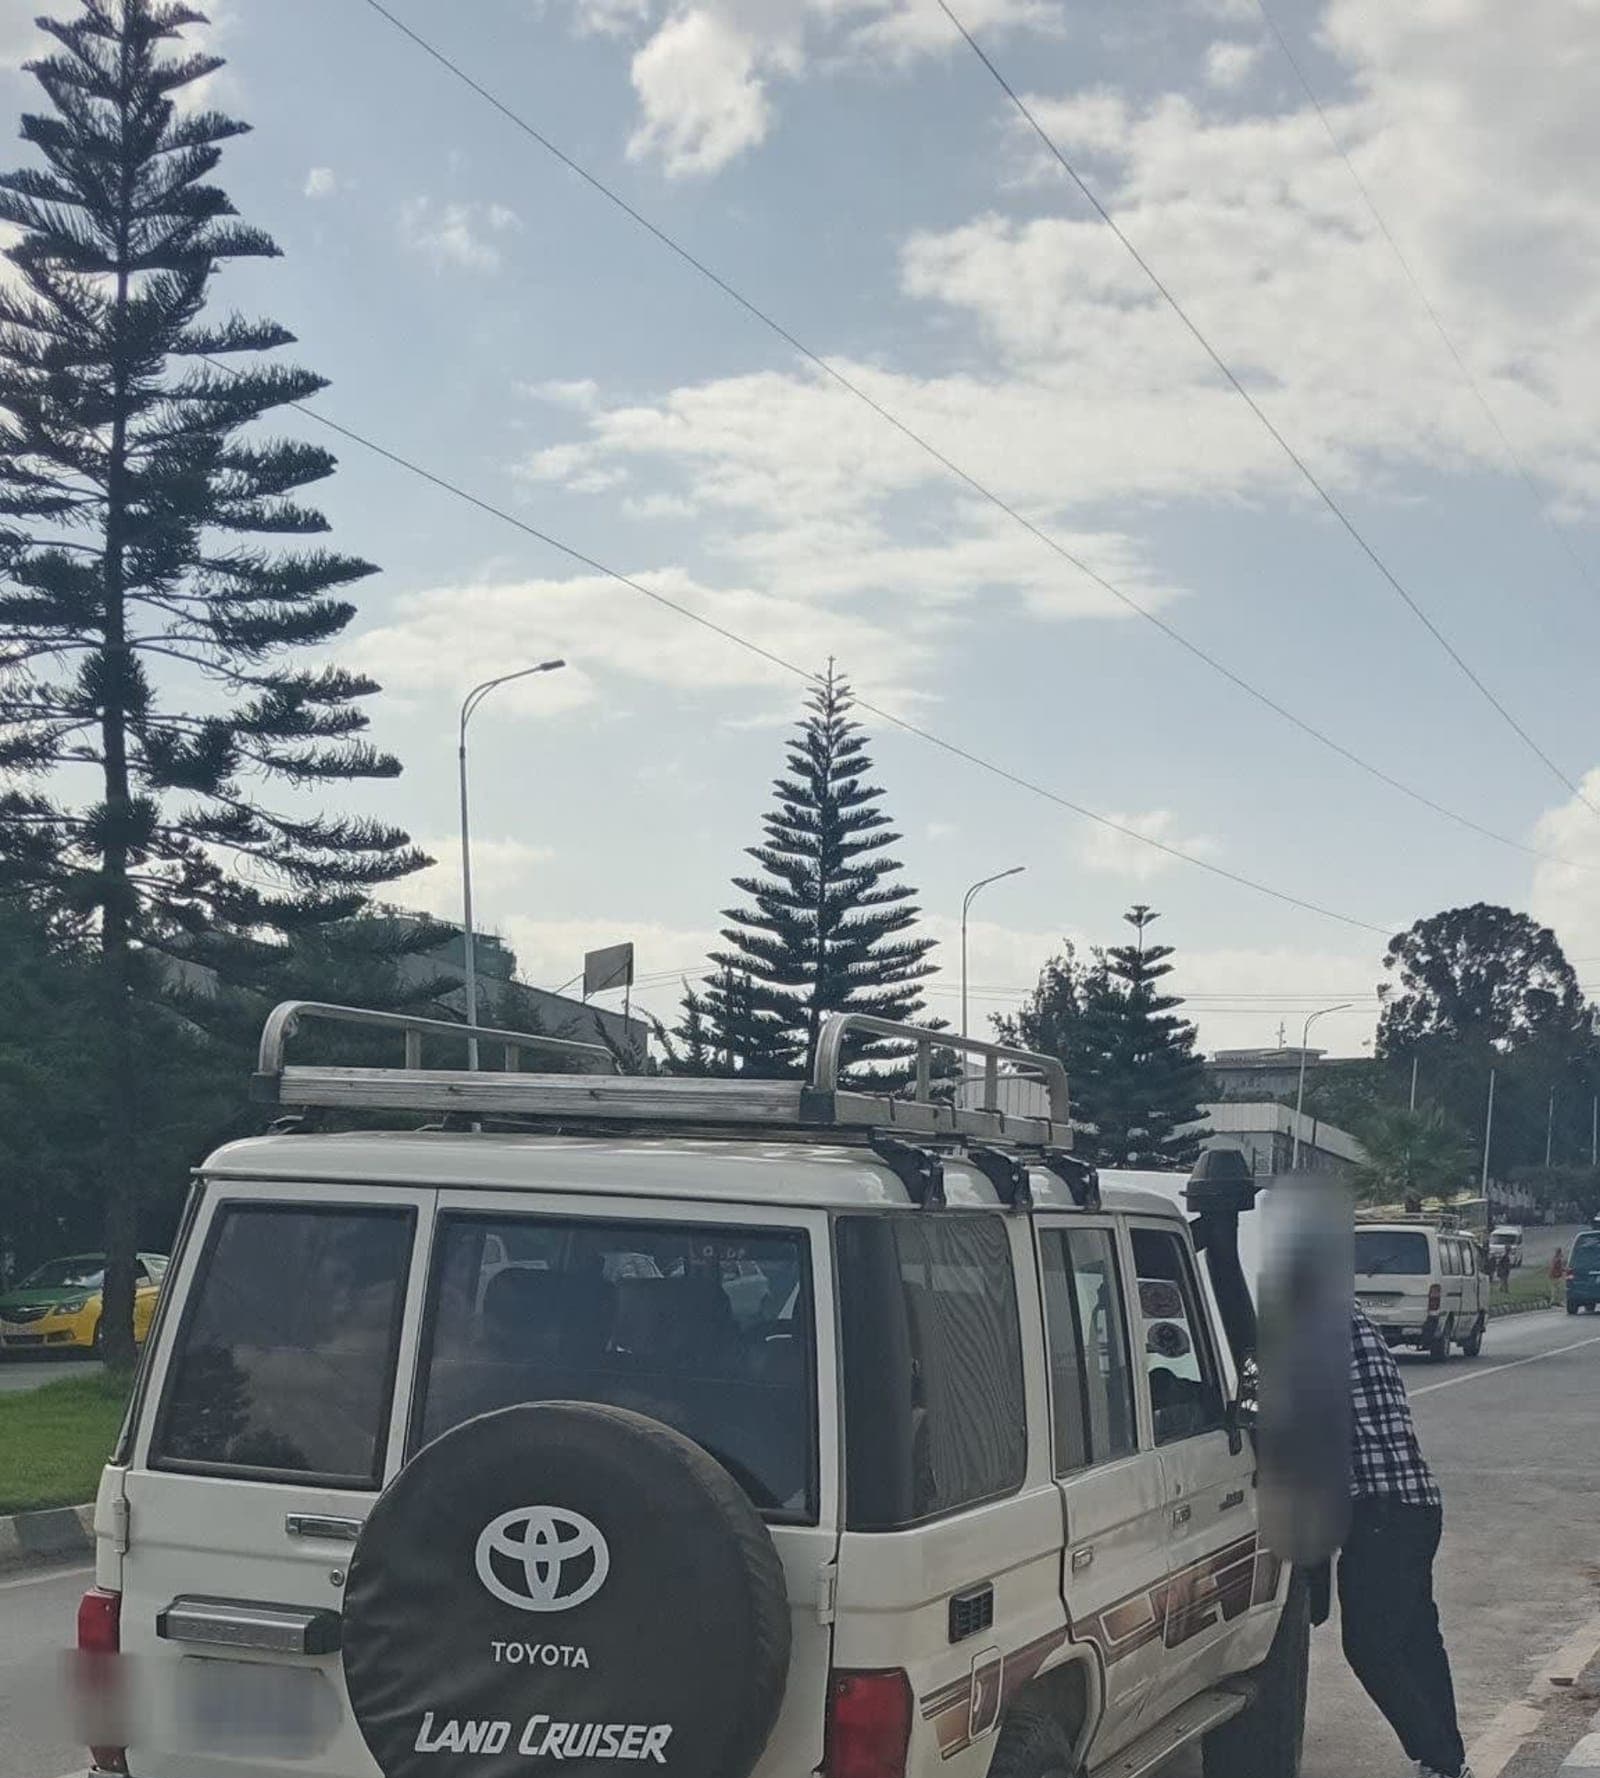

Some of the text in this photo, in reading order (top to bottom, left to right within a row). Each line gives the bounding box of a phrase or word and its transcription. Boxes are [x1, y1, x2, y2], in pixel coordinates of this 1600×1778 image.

[491, 1641, 590, 1668] TOYOTA
[414, 1711, 673, 1763] LAND CRUISER
